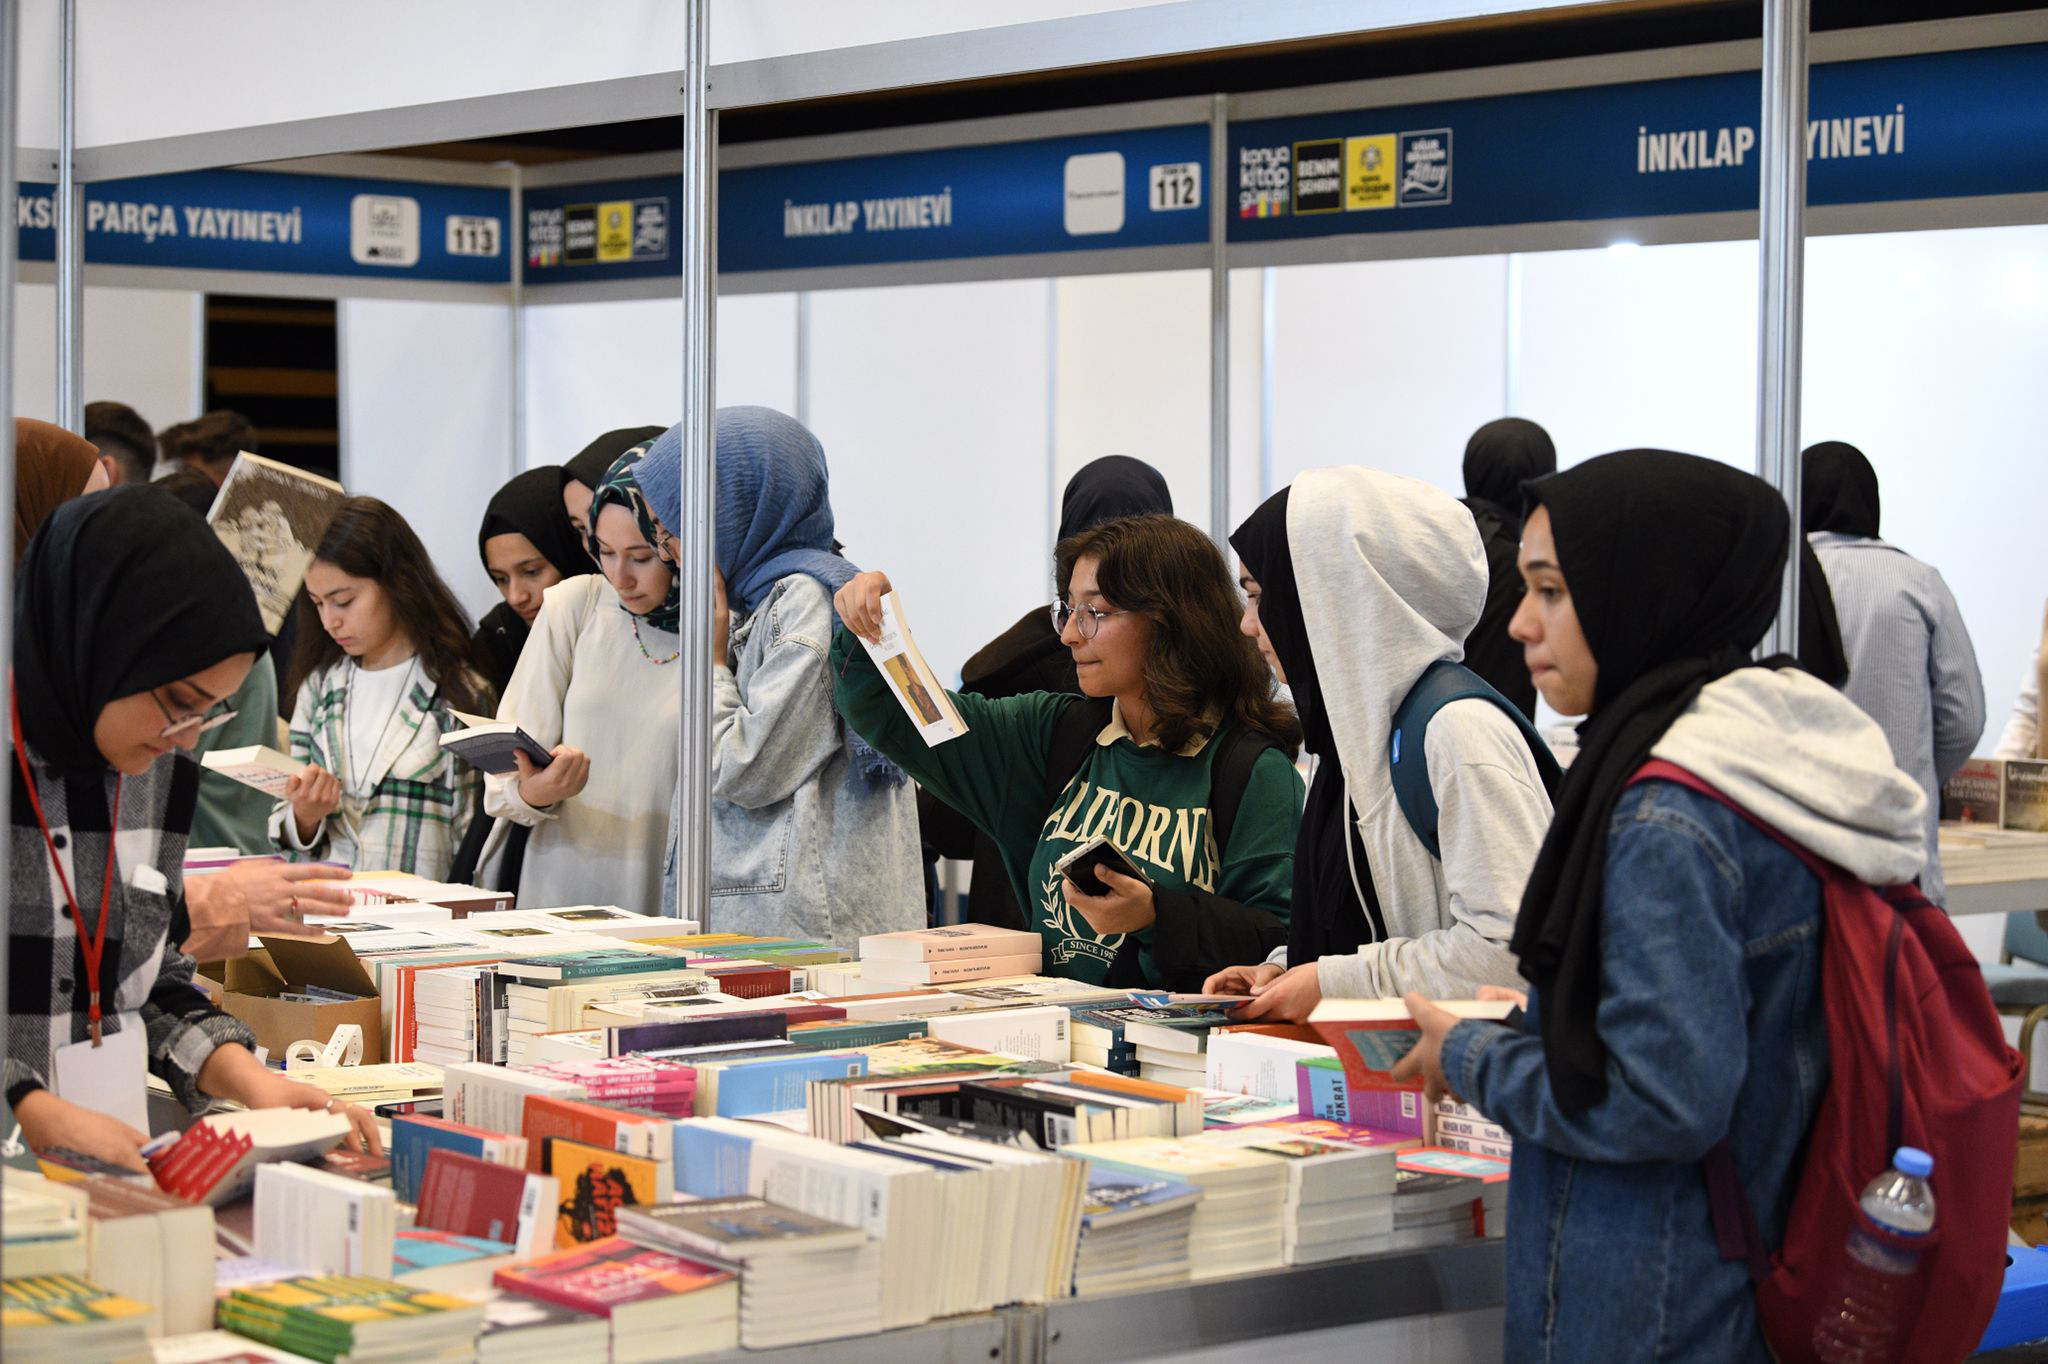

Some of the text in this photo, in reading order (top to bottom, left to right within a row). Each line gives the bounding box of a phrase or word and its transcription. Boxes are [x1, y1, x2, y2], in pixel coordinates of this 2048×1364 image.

[1637, 104, 1905, 174] İNKILAP YINEVİ
[784, 186, 953, 238] İNKILAP YAYINEVİ
[1157, 176, 1195, 207] 112
[17, 192, 302, 244] KSİ PARÇA YAYINEVİ
[453, 227, 493, 253] 113
[1070, 941, 1098, 954] SINCE
[1332, 1079, 1348, 1122] POKRAT
